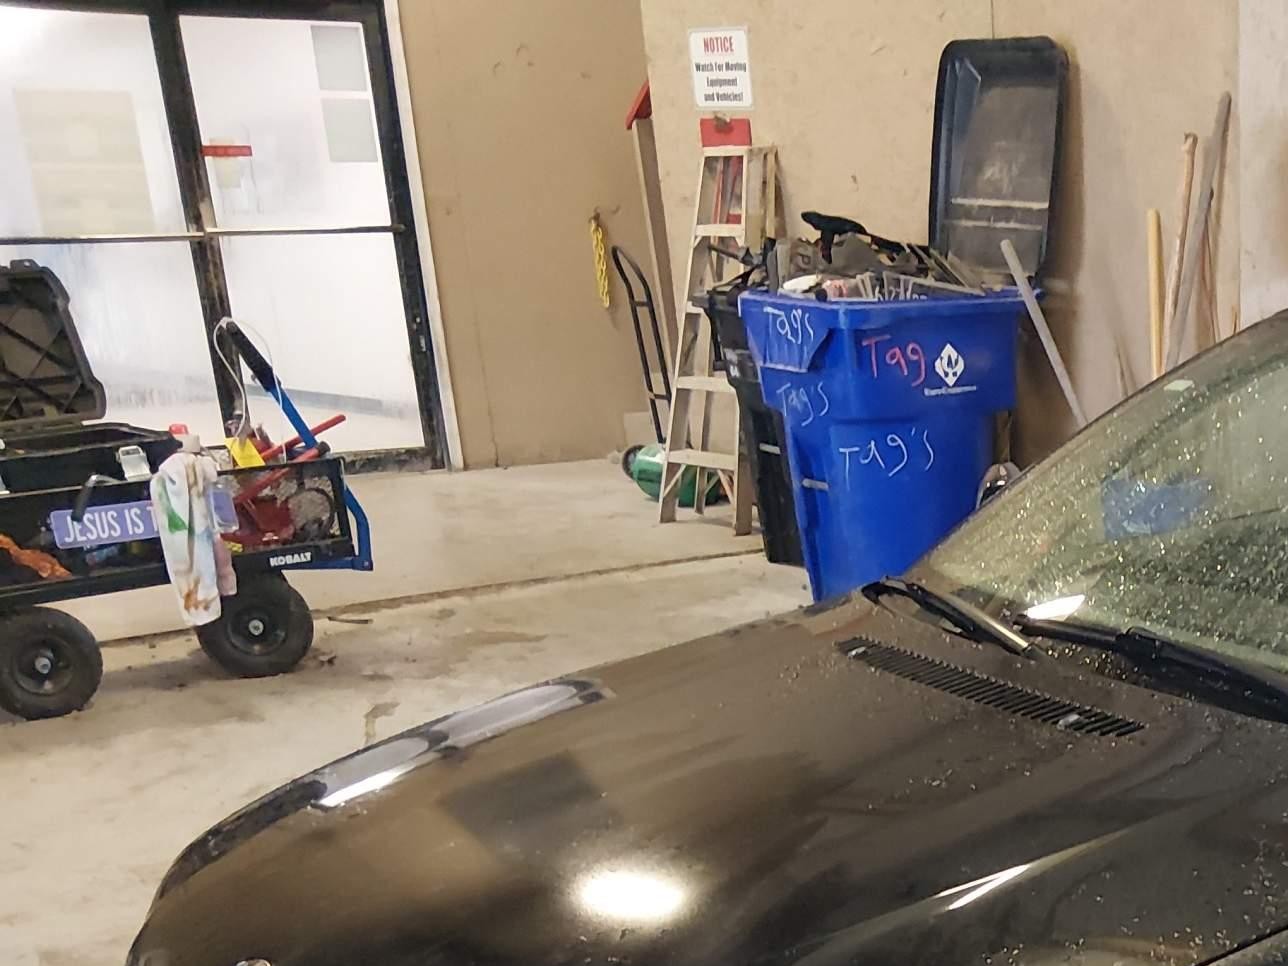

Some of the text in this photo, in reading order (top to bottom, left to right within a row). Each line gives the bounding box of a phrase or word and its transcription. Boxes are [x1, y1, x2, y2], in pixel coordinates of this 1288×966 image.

[704, 36, 735, 53] NOTICE
[695, 61, 714, 72] Watch
[725, 60, 747, 72] Moving
[707, 76, 738, 88] Equipment
[64, 510, 121, 542] JESUS
[124, 507, 145, 535] IS
[269, 552, 312, 567] KOBALT
